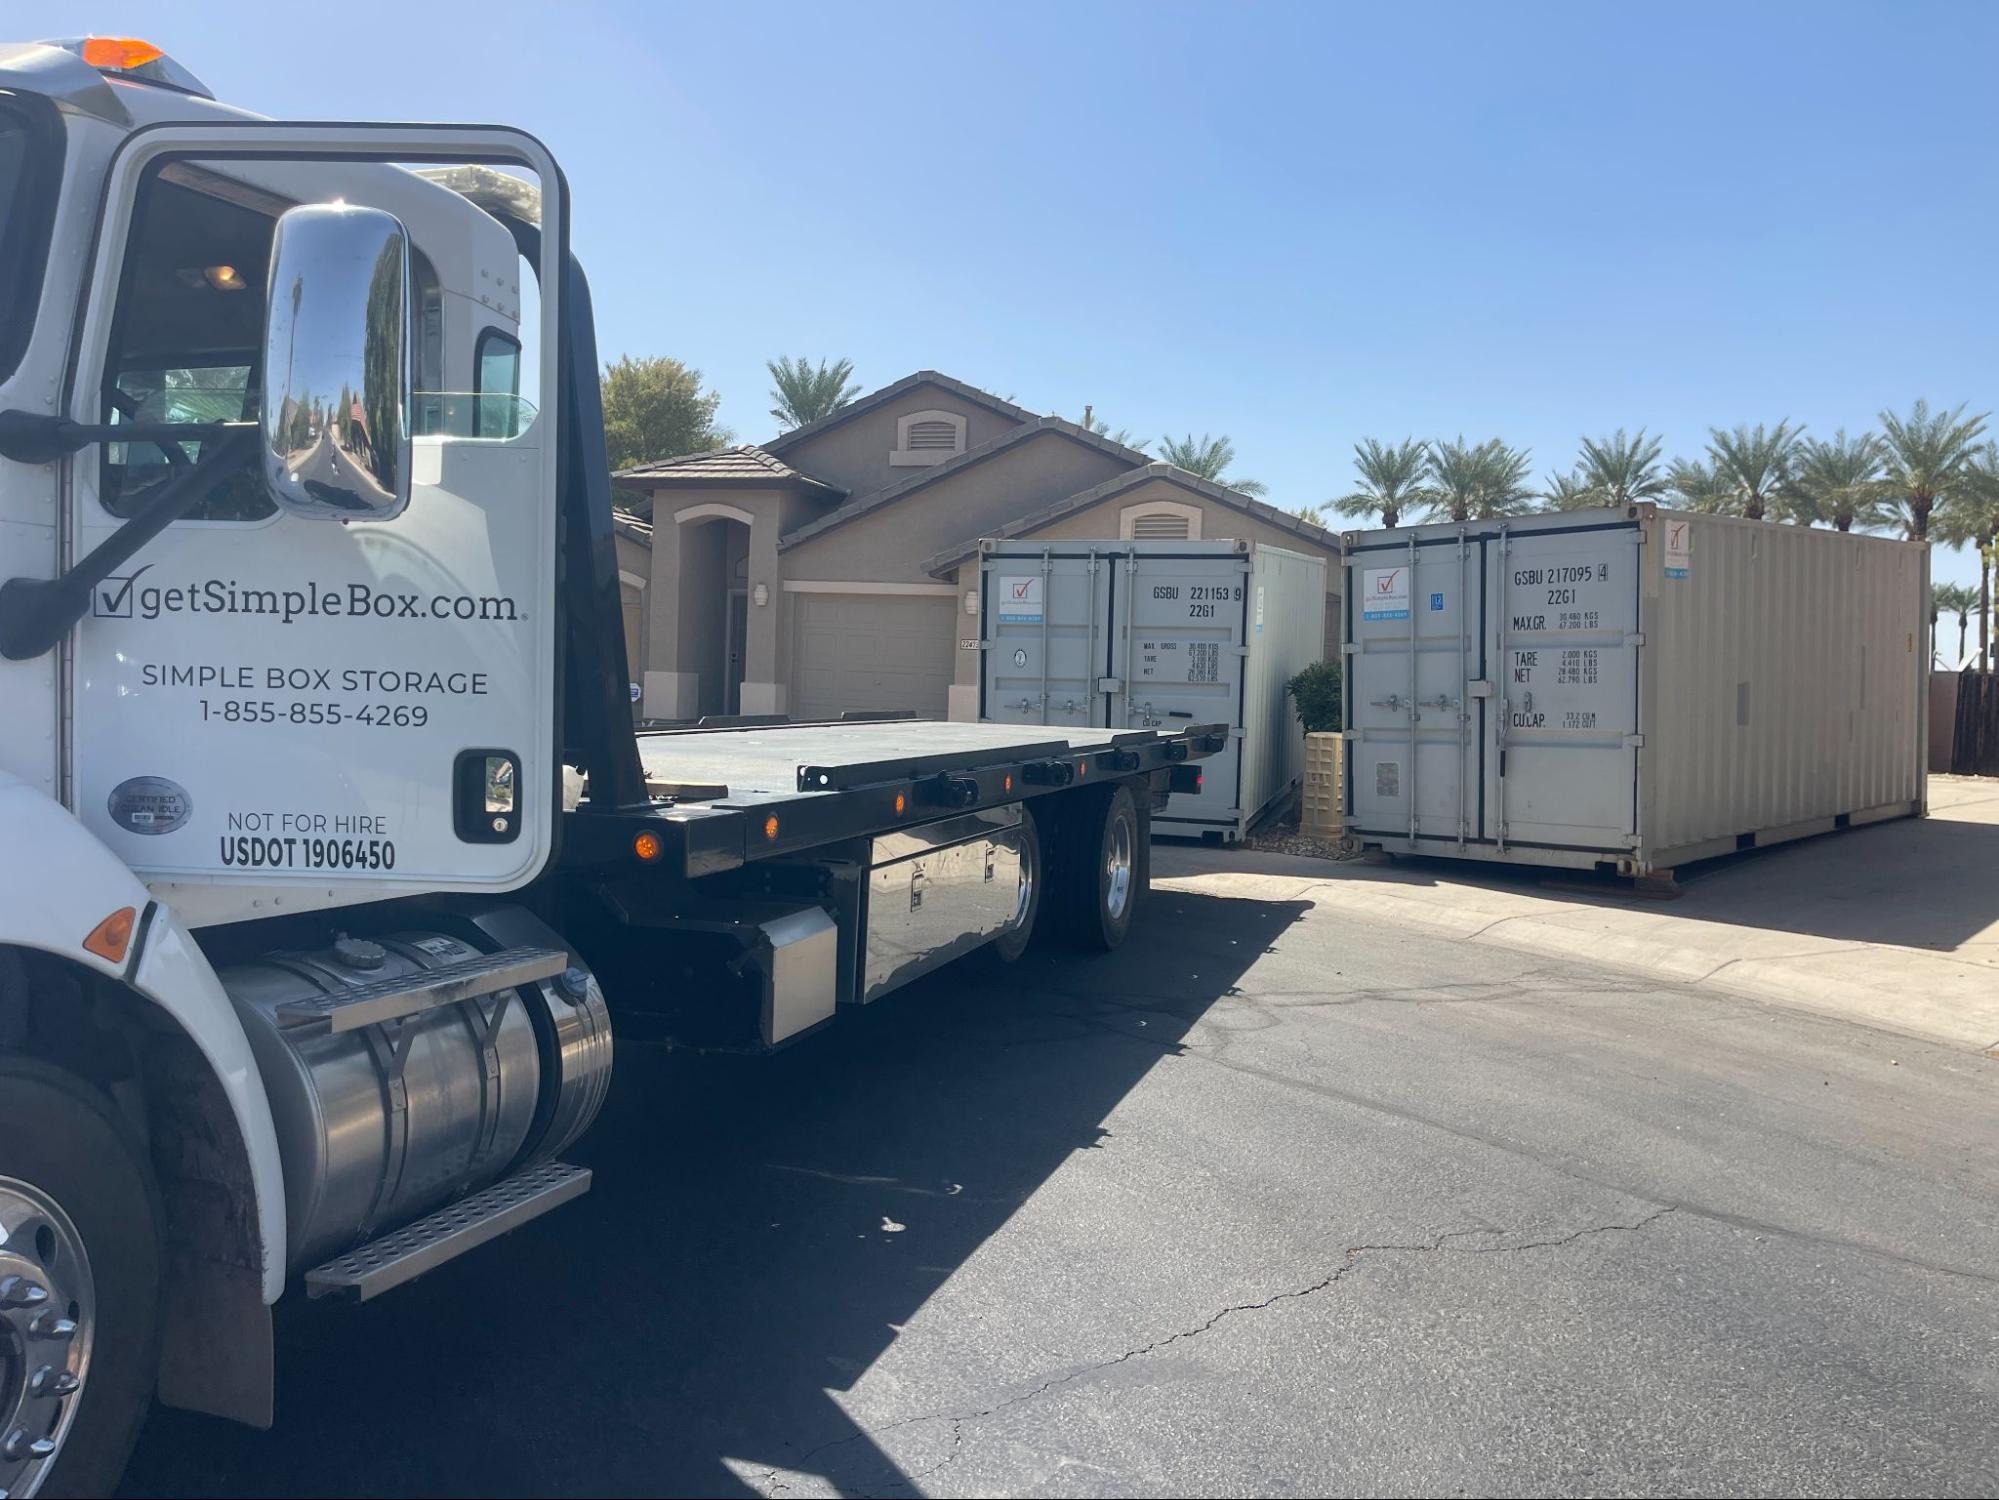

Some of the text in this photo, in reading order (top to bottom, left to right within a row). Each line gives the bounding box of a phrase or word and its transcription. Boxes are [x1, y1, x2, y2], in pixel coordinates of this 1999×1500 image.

[1515, 564, 1607, 586] GSBU 217095 4
[141, 580, 518, 624] getSimpleBox.com
[1153, 586, 1241, 601] GSBU 221153 9
[1547, 588, 1576, 605] 22G1
[1189, 604, 1215, 618] 22G1
[1584, 611, 1599, 620] KGS
[1584, 620, 1598, 629] LBS
[1515, 652, 1539, 667] TARE
[1583, 650, 1598, 659] KGS
[1583, 659, 1598, 667] LBS
[142, 664, 488, 695] SIMPLE BOX STORAGE
[1514, 668, 1531, 683] NET
[1583, 667, 1598, 676] KGS
[1583, 675, 1598, 684] LBS
[200, 700, 428, 727] 1-855-855-4269
[229, 812, 387, 834] NOT FOR HIRE
[221, 836, 395, 870] USDOT 1906450
